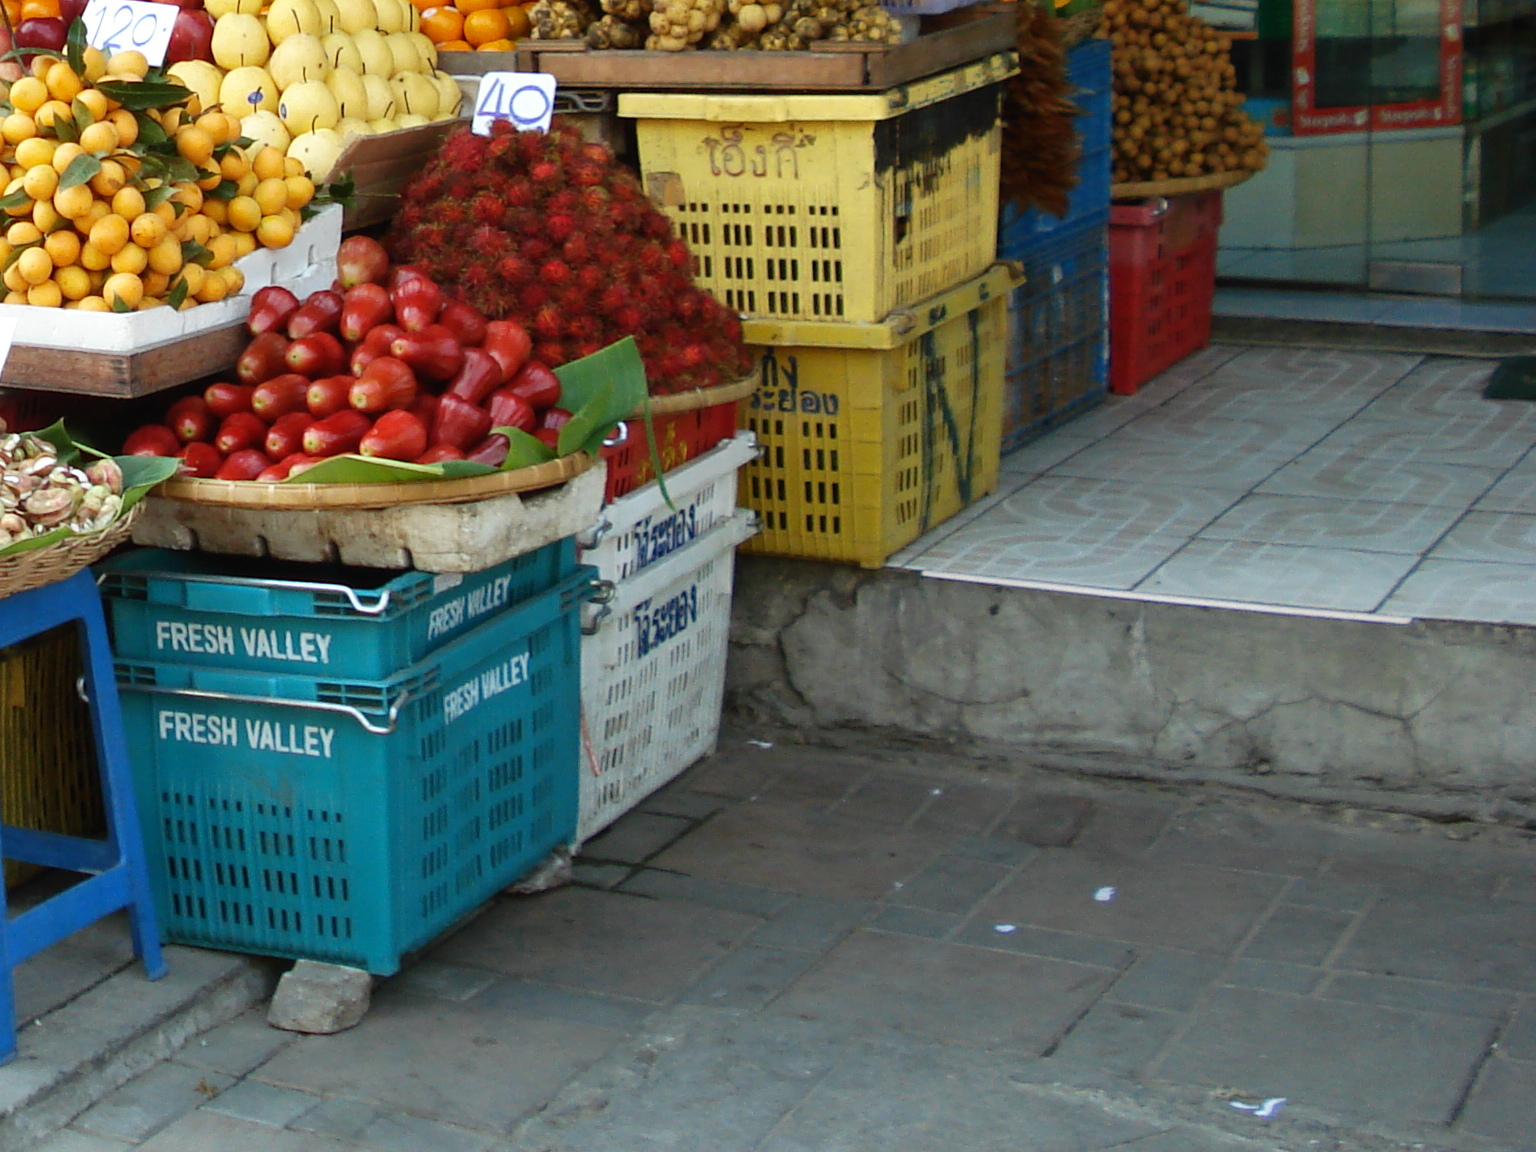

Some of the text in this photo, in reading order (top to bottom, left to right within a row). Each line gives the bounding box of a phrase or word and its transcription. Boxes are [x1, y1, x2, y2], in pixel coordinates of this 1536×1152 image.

[428, 574, 511, 641] FRESH VALLEY
[156, 621, 331, 665] FRESH VALLEY
[443, 652, 530, 725] FRESH VALLEY
[159, 710, 335, 758] FRESH VALLEY
